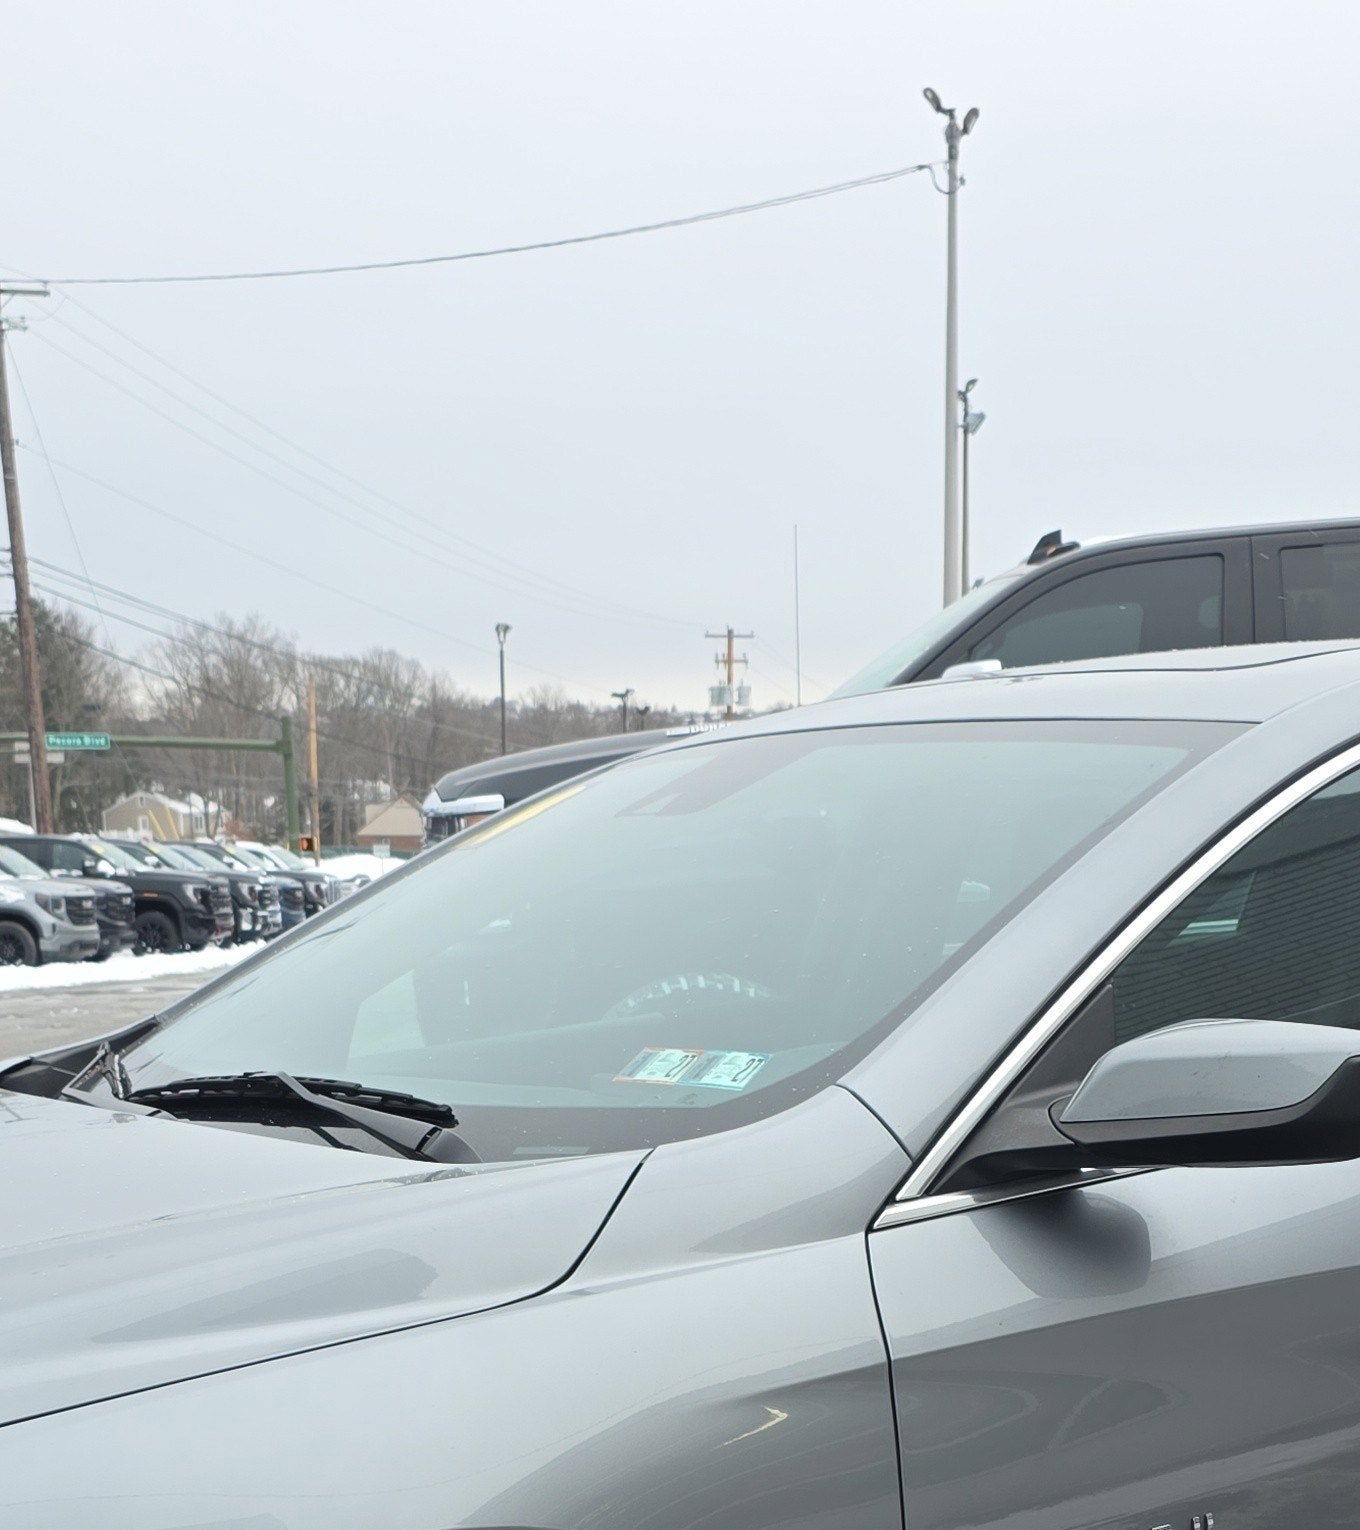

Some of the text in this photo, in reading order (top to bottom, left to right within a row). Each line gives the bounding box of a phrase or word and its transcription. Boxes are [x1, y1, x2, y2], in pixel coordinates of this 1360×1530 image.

[83, 734, 106, 746] Blvd
[664, 1054, 698, 1079] 27
[730, 1058, 765, 1083] 27
